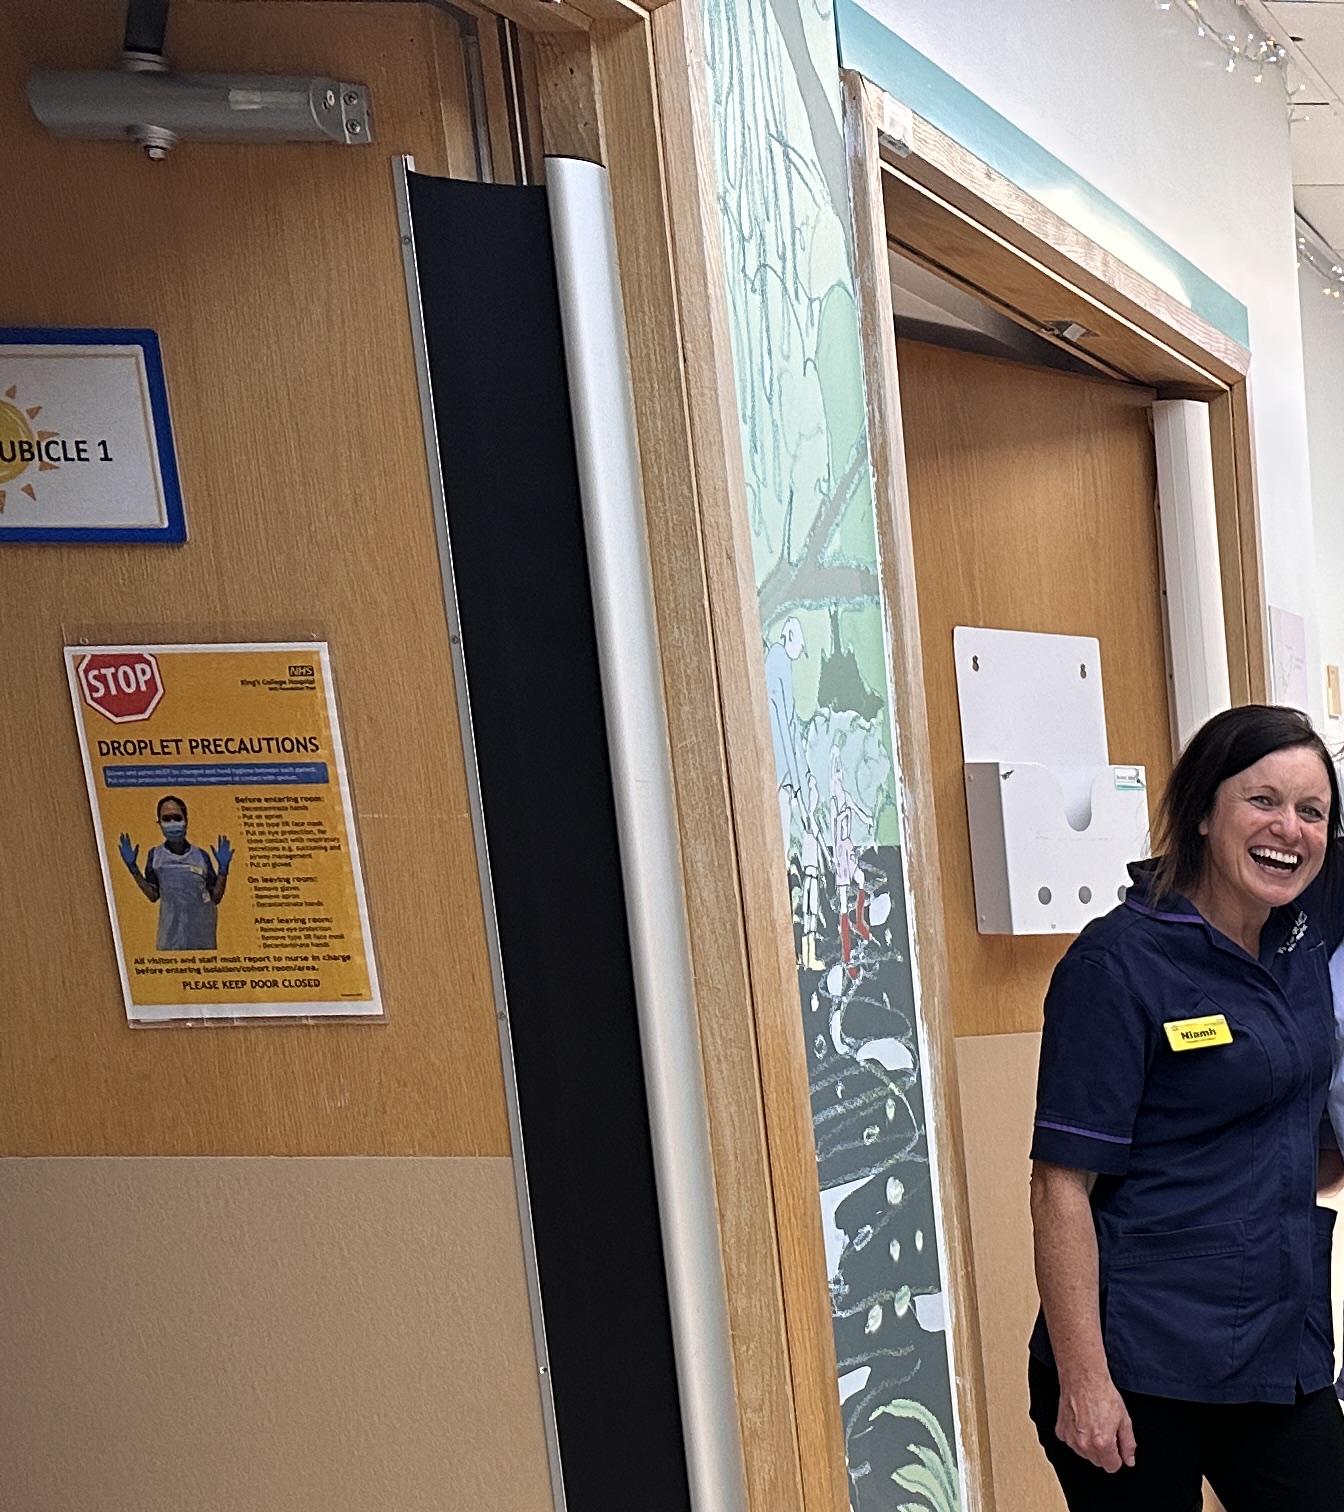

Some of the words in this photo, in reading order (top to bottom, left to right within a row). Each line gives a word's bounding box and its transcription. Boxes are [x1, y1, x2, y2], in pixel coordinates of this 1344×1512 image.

[0, 440, 90, 462] UBICLE
[98, 440, 113, 461] 1
[290, 666, 313, 675] NHS
[88, 663, 151, 698] STOP
[98, 738, 183, 757] DROPLET
[190, 736, 320, 755] PRECAUTIONS
[182, 980, 220, 990] PLEASE
[222, 980, 247, 989] KEEP
[250, 979, 279, 989] DOOR
[282, 979, 321, 988] CLOSED
[1181, 1028, 1217, 1040] Niamh
